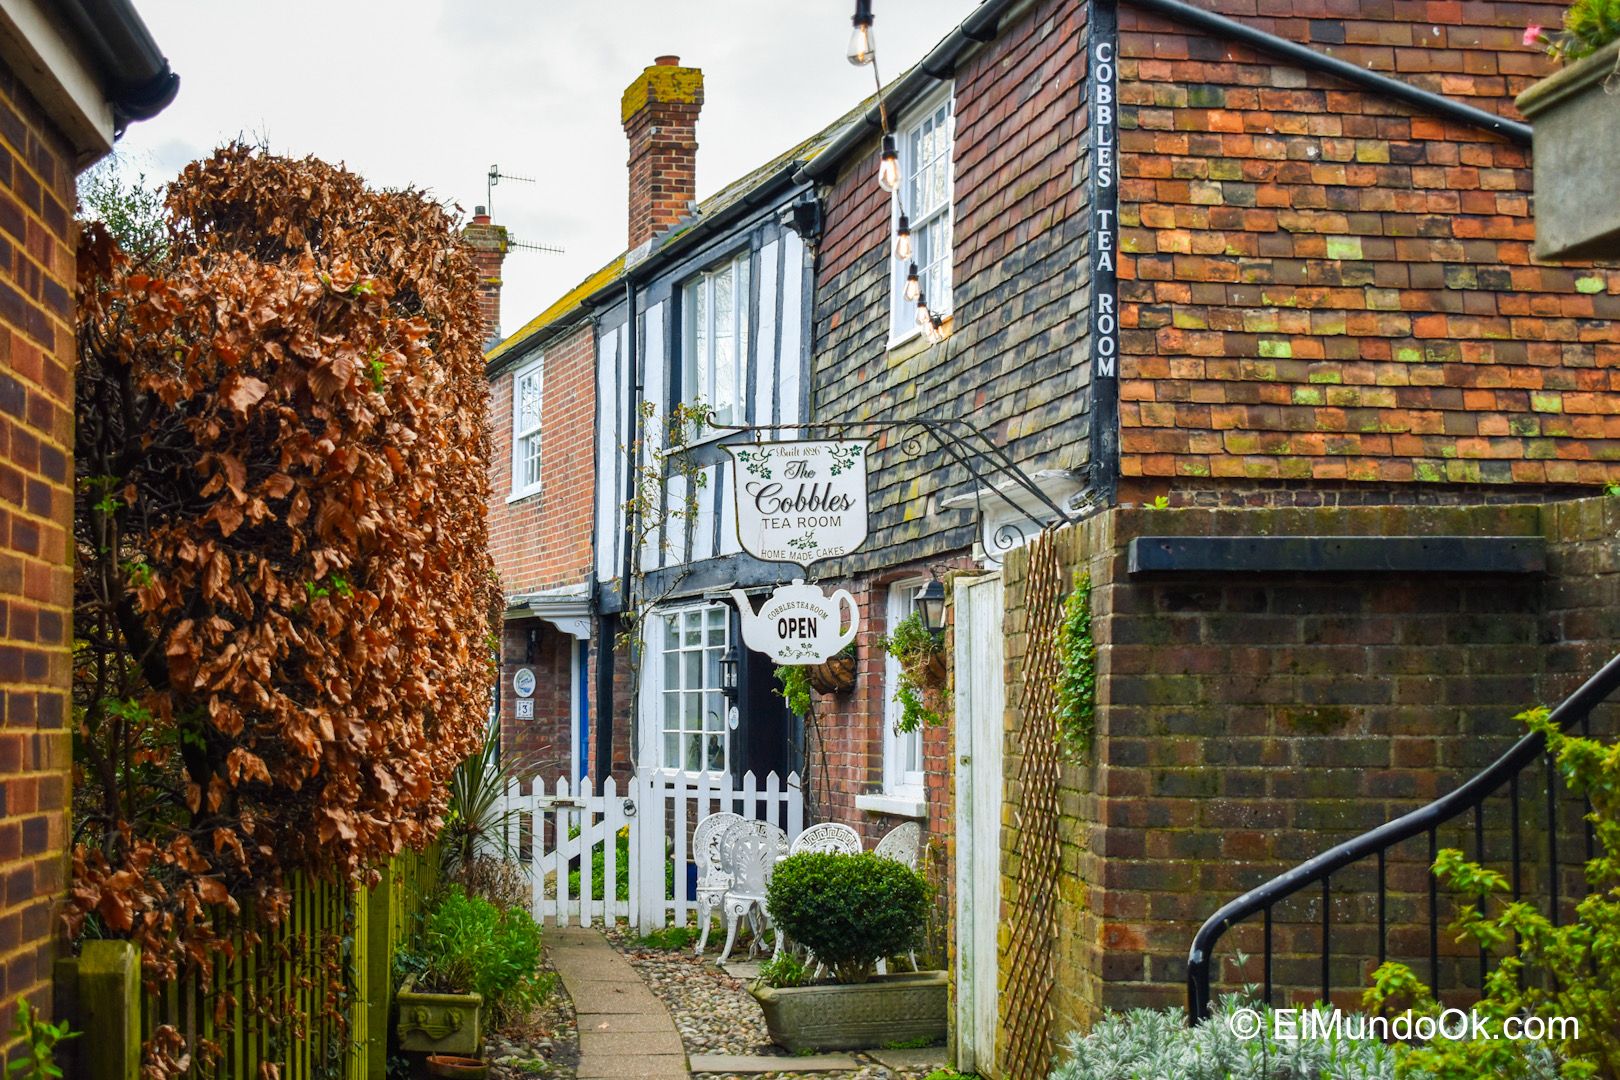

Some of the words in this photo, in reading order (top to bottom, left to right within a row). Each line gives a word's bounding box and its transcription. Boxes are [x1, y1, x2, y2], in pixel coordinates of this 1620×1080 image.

[1095, 42, 1113, 188] COBBLES
[1096, 209, 1114, 272] TEA
[1096, 293, 1116, 378] ROOM
[783, 460, 816, 480] The
[745, 481, 856, 515] Cobbles
[762, 517, 792, 529] TEA
[797, 516, 841, 528] ROOM
[761, 549, 786, 559] HOME
[789, 550, 813, 560] MADE
[817, 546, 845, 558] CAKES
[767, 601, 796, 621] COBBLES
[796, 601, 809, 609] TEA
[810, 605, 828, 620] ROOM
[777, 617, 817, 639] OPEN
[522, 704, 528, 714] 3
